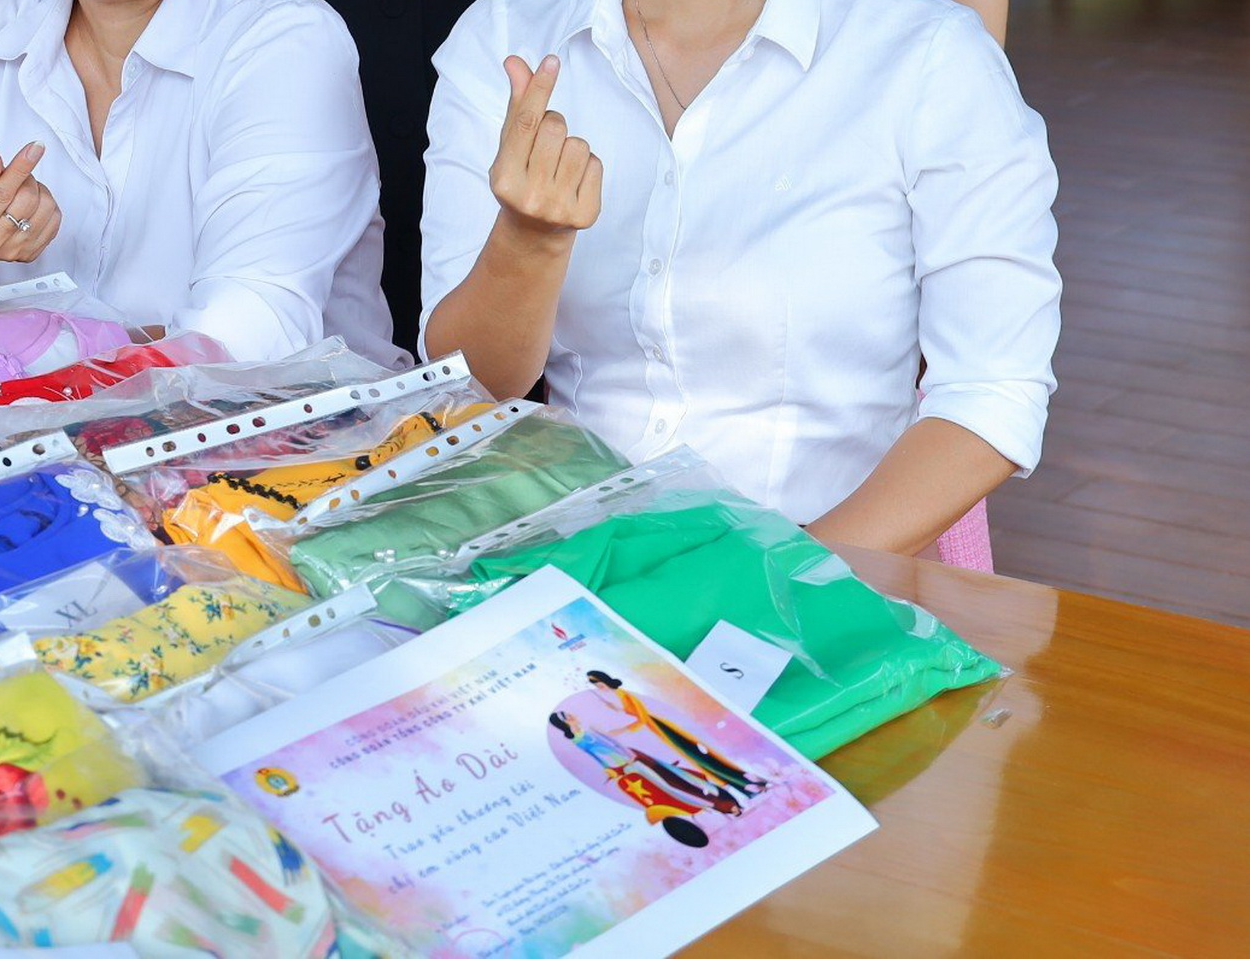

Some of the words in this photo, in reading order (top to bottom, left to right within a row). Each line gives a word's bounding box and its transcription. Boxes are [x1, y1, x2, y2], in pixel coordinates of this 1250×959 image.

[54, 600, 98, 629] XL
[513, 663, 537, 678] NAM
[719, 661, 744, 680] S
[321, 801, 412, 844] Tặng
[413, 768, 456, 805] Áo
[455, 742, 519, 780] Dài
[506, 804, 546, 828] Việt
[543, 789, 581, 807] Nam
